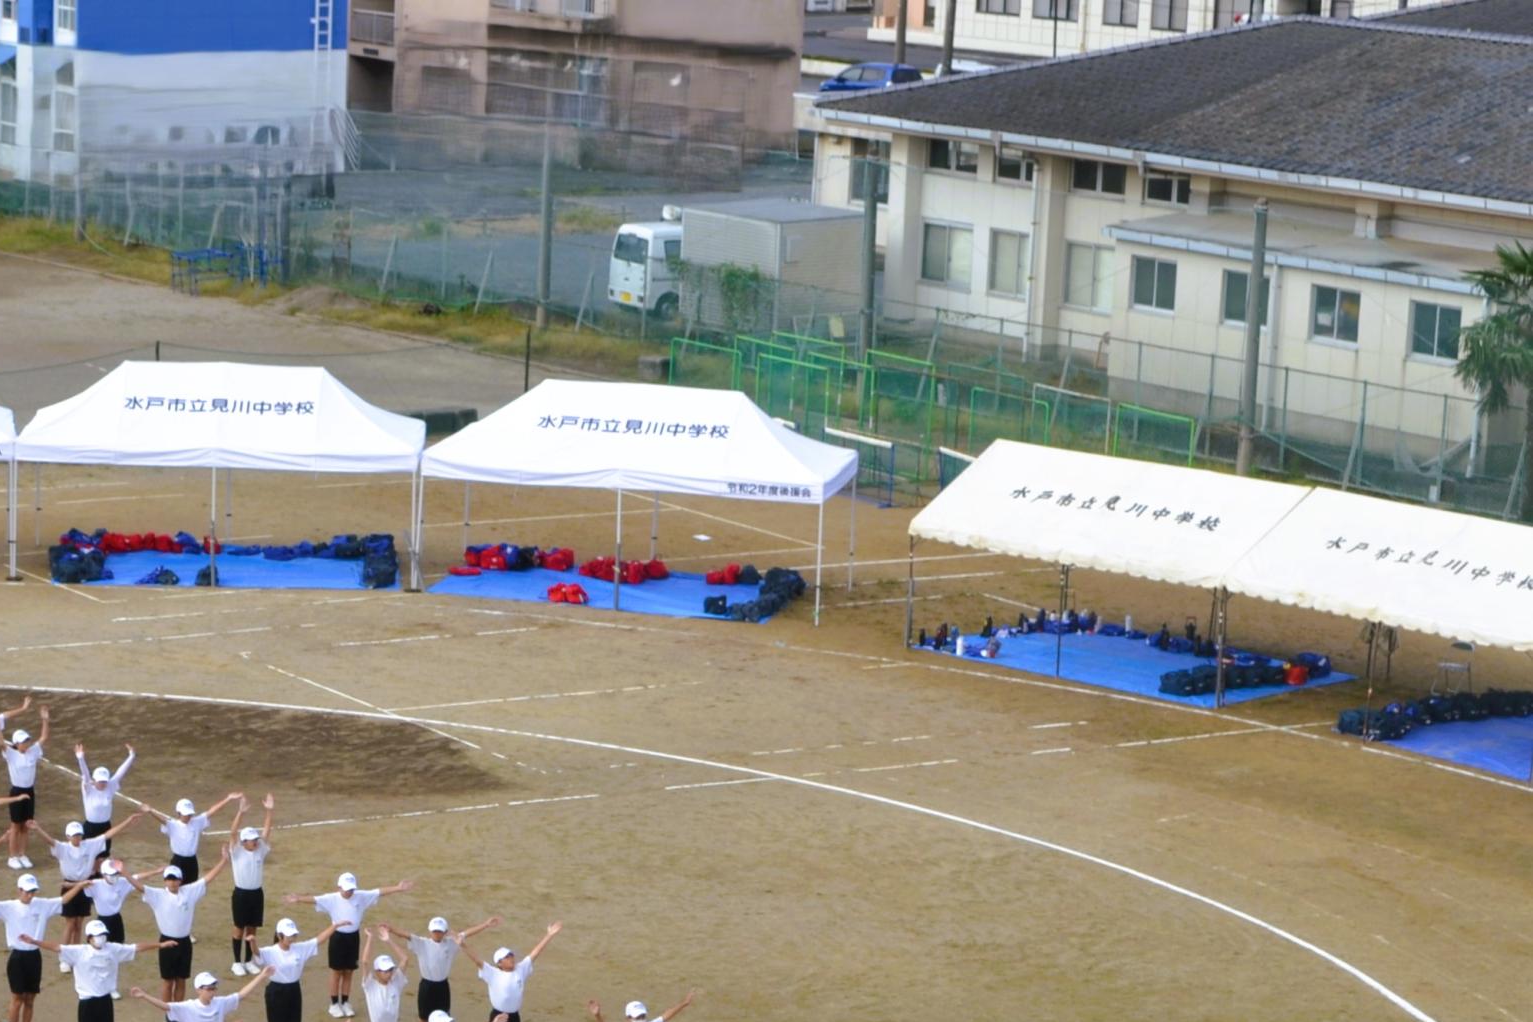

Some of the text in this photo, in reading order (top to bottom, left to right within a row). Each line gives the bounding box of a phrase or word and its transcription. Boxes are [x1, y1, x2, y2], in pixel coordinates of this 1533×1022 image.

[124, 396, 315, 415] 水戸市立見川中学校
[537, 414, 731, 439] 水戸市立見川中学校
[1010, 486, 1221, 532] 水戸市立見川中学校
